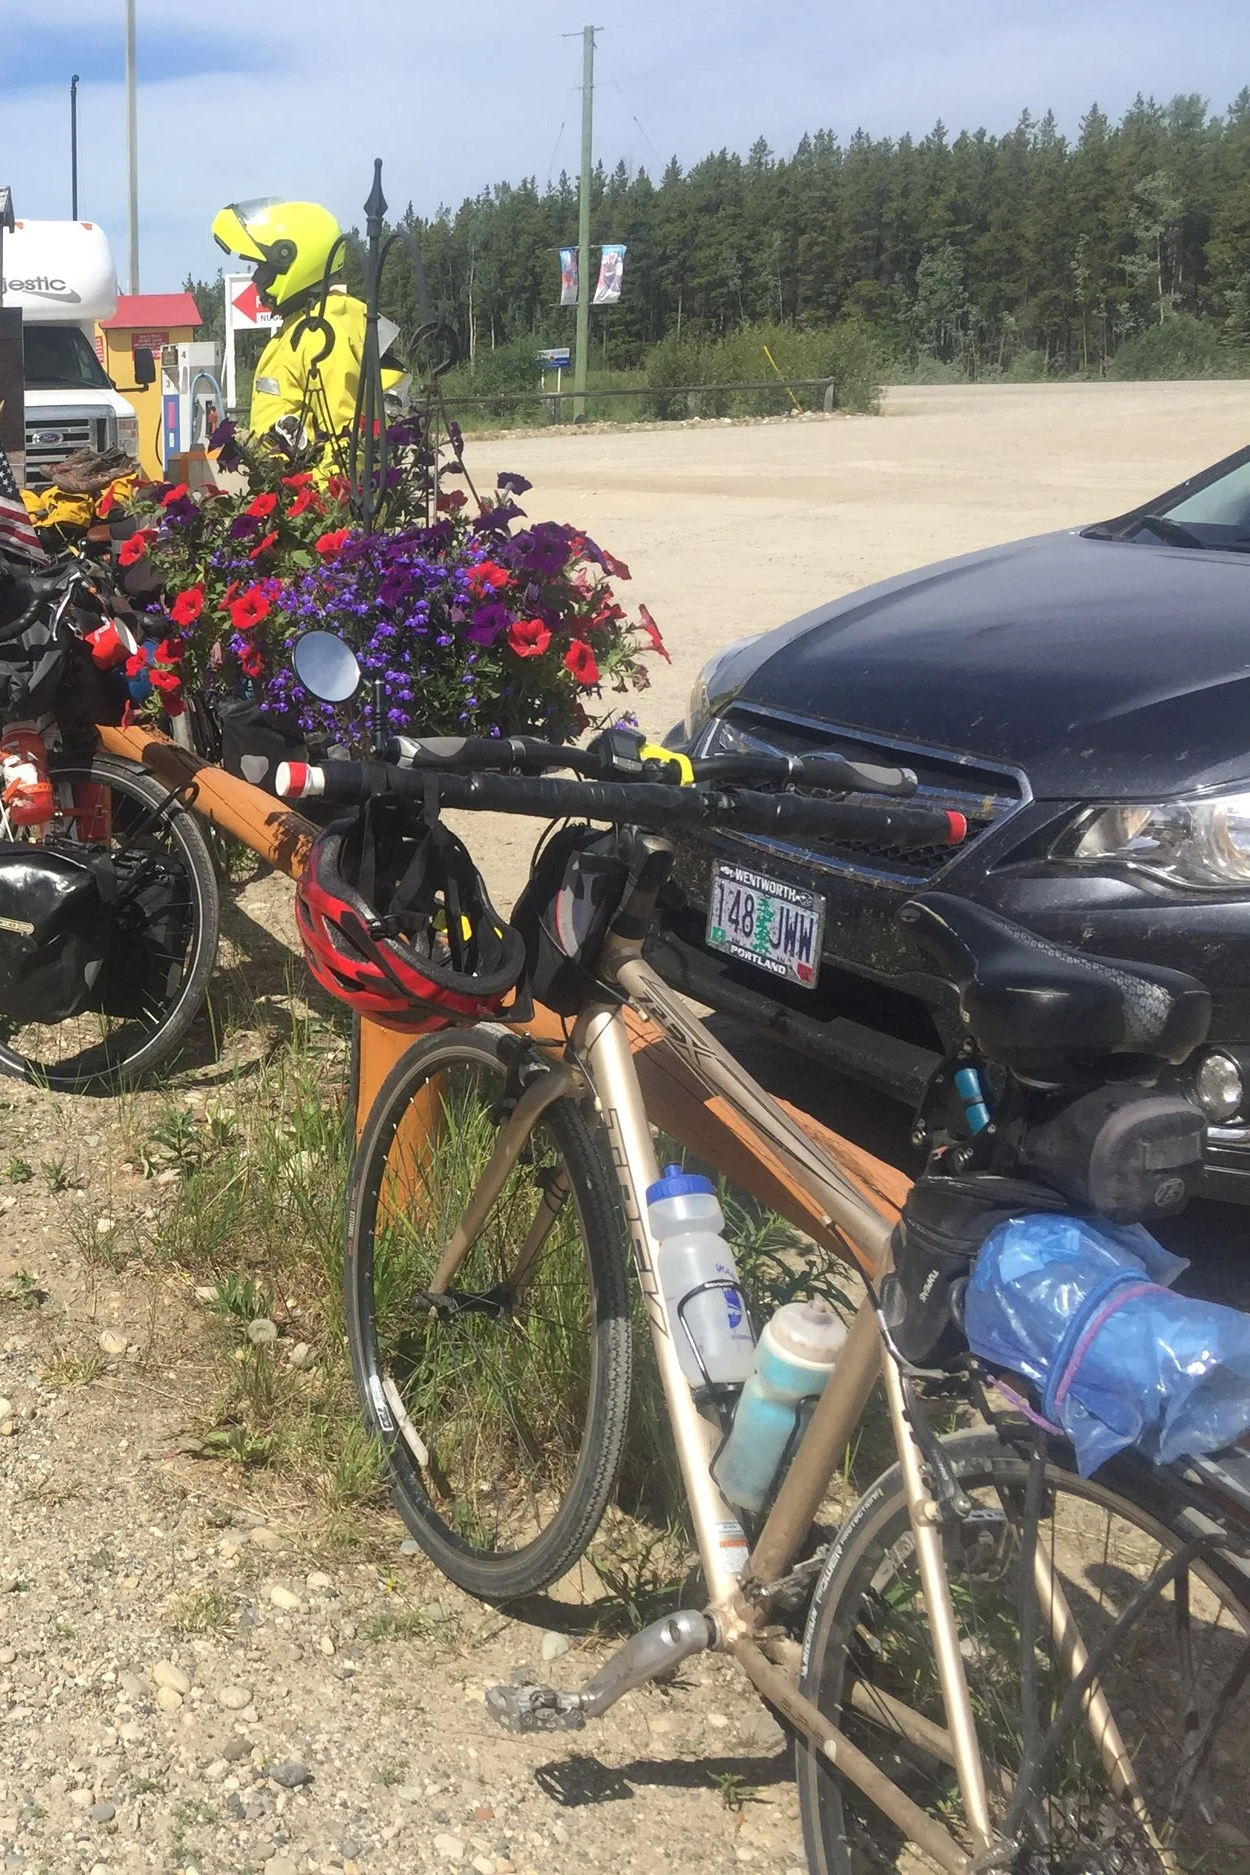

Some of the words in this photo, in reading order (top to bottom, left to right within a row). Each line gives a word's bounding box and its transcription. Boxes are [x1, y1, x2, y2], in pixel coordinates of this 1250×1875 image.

[735, 868, 797, 901] WENTWORTH
[717, 882, 755, 938] 148
[730, 944, 786, 975] PORTLAND
[815, 1544, 843, 1604] POWER
